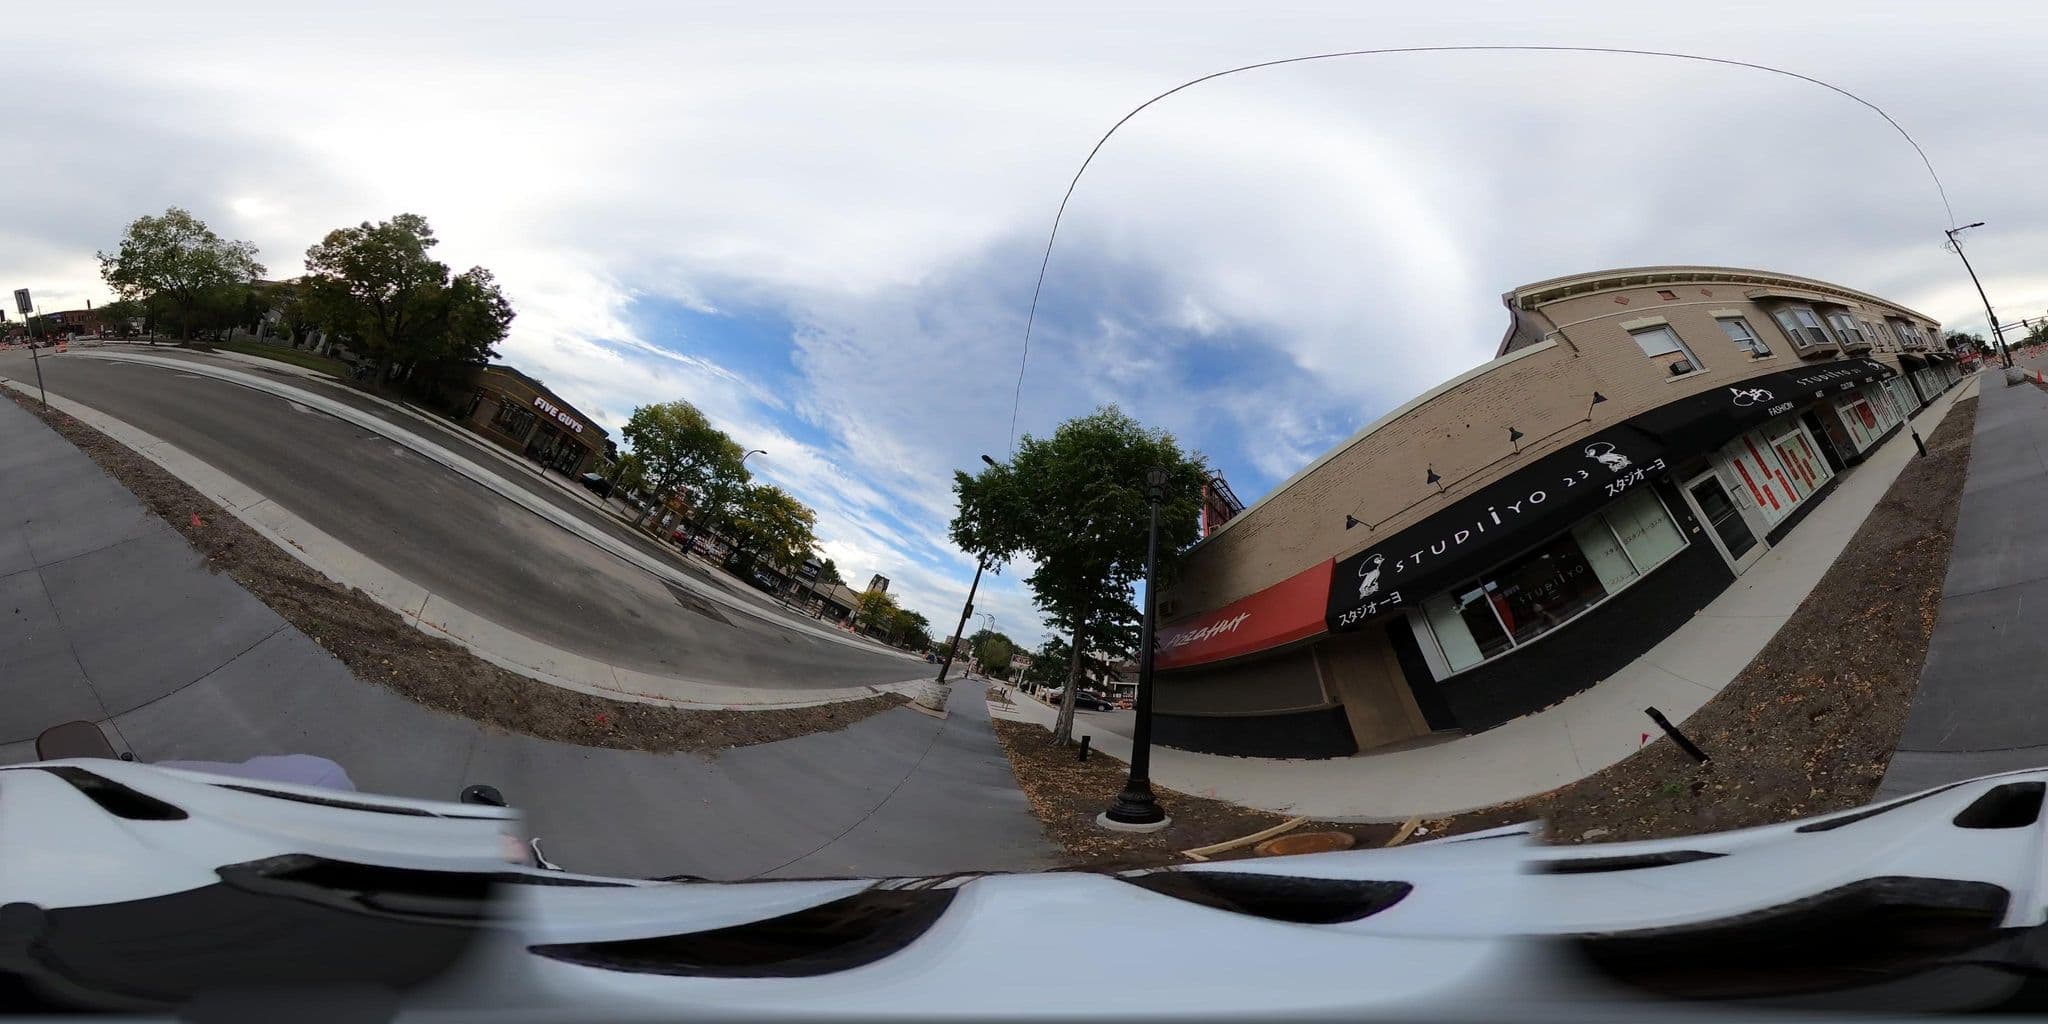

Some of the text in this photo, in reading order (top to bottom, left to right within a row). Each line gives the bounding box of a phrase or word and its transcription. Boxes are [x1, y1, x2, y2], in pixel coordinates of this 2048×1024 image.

[534, 397, 584, 433] FIVE GUYS
[1767, 401, 1795, 417] FASHION
[1604, 458, 1666, 497] スタジオーヨ
[1338, 590, 1402, 627] スタジオーヨ
